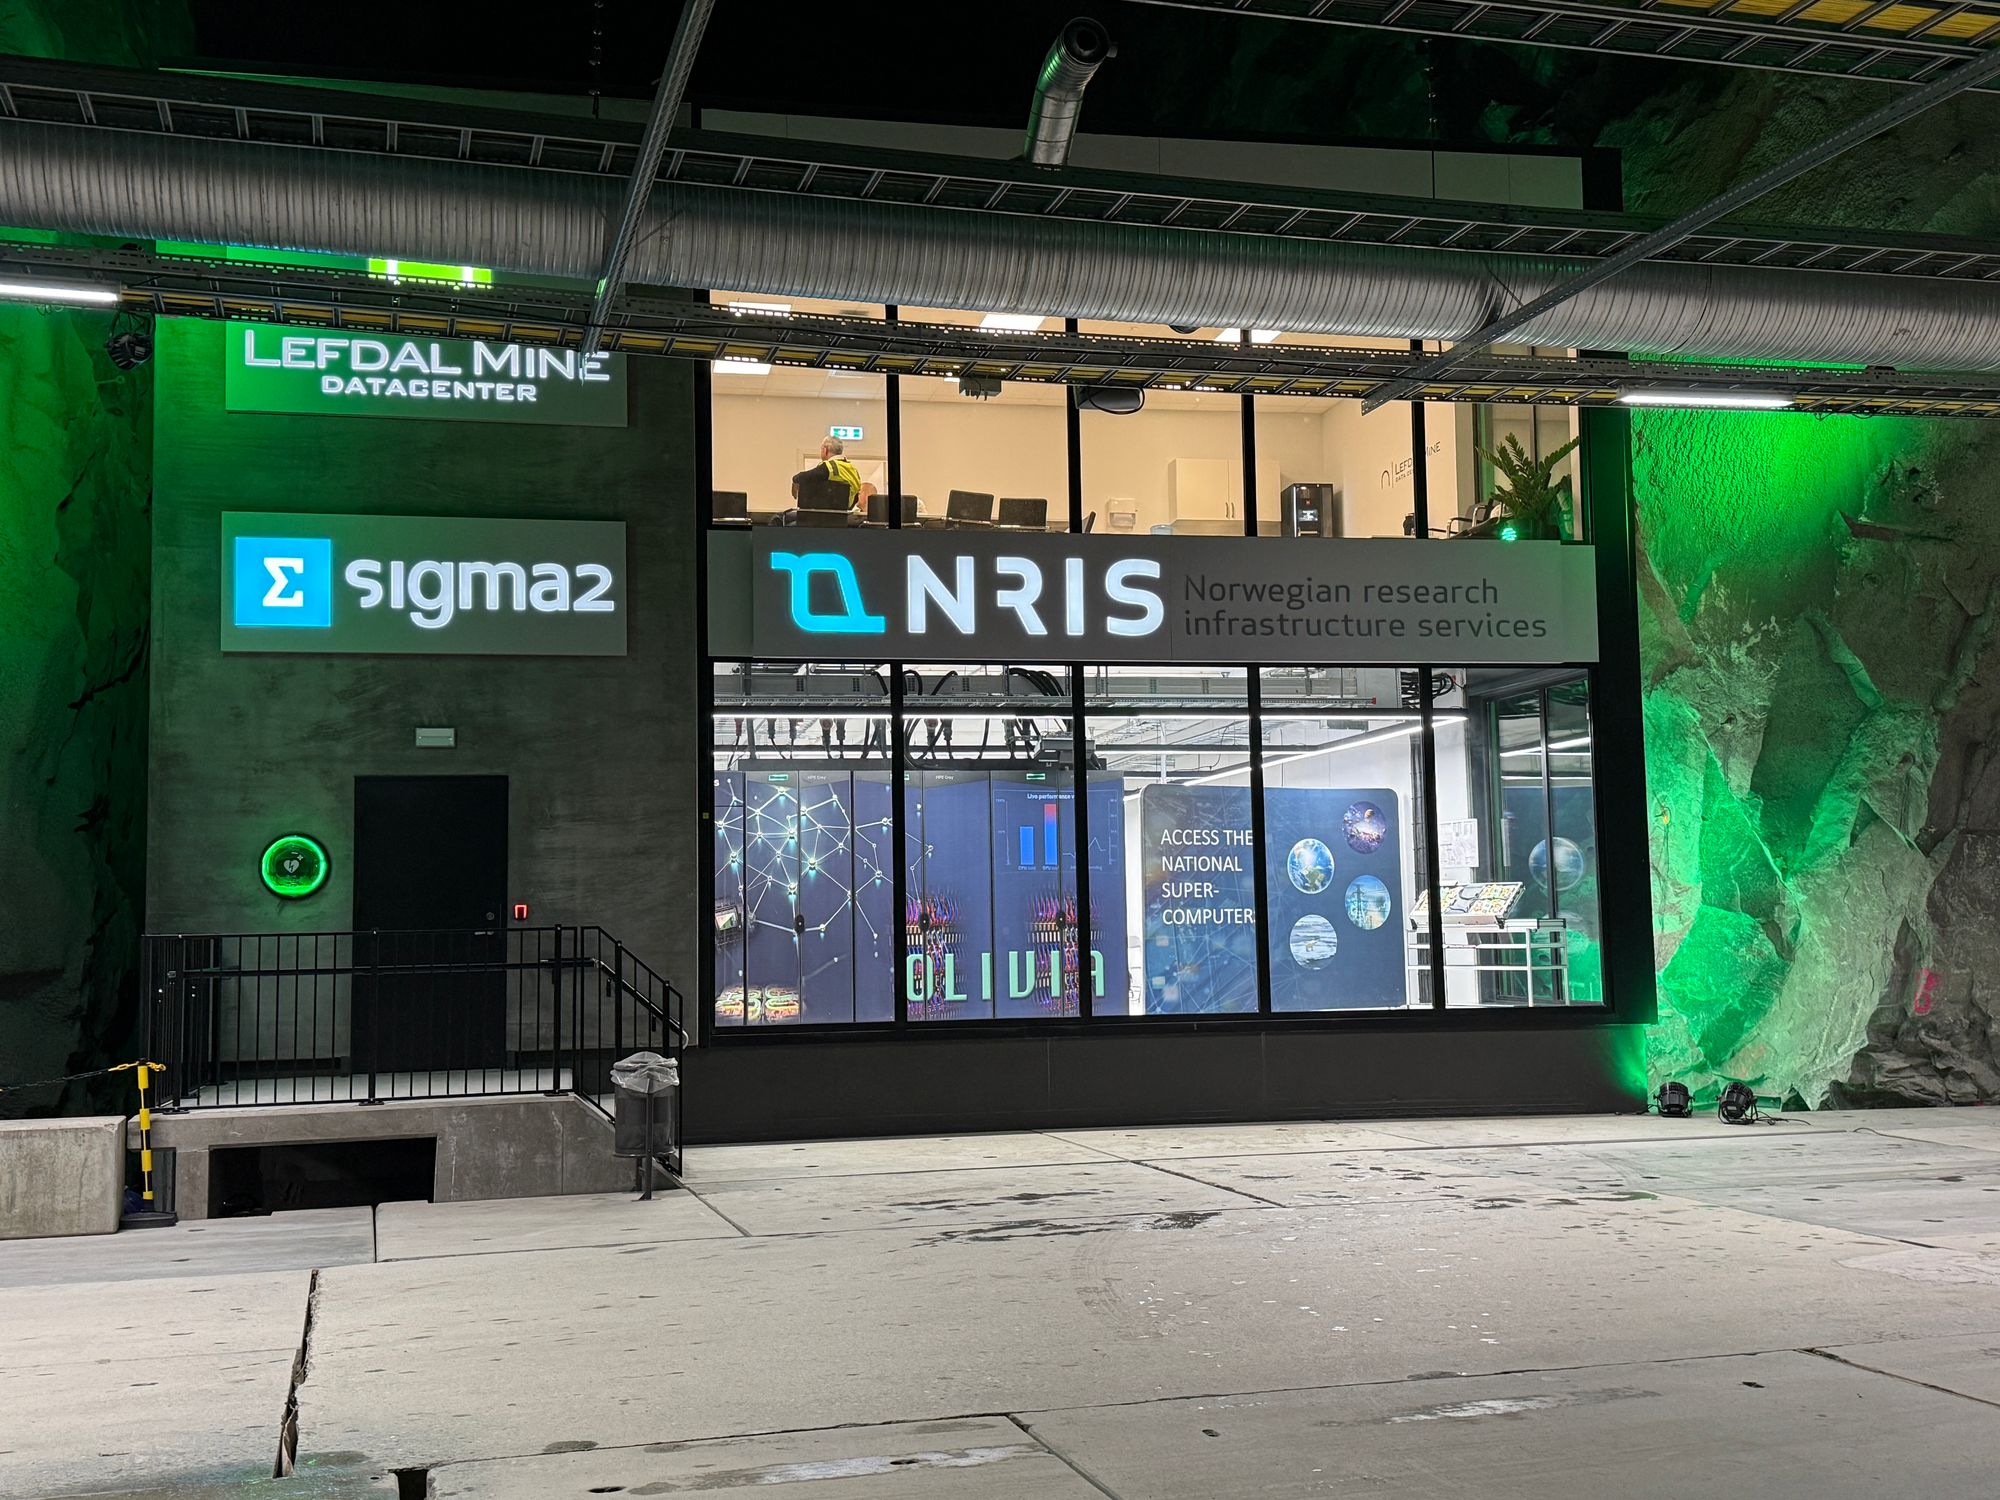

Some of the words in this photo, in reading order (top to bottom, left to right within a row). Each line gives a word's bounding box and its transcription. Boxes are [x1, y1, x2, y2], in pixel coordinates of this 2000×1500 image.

[244, 329, 462, 375] LEFDAL
[473, 341, 610, 381] MINE
[321, 375, 537, 402] DATACENTER
[345, 559, 615, 629] sigma2
[907, 554, 1165, 637] NRIS
[1185, 575, 1351, 610] Norwegian
[1363, 578, 1498, 605] research
[1185, 611, 1406, 638] infrastructure
[1418, 613, 1547, 639] services
[1160, 829, 1219, 846] ACCESS
[1223, 829, 1253, 846] THE
[1162, 856, 1243, 872] NATIONAL
[1162, 882, 1220, 898] SUPER-
[1162, 908, 1255, 925] COMPUTER
